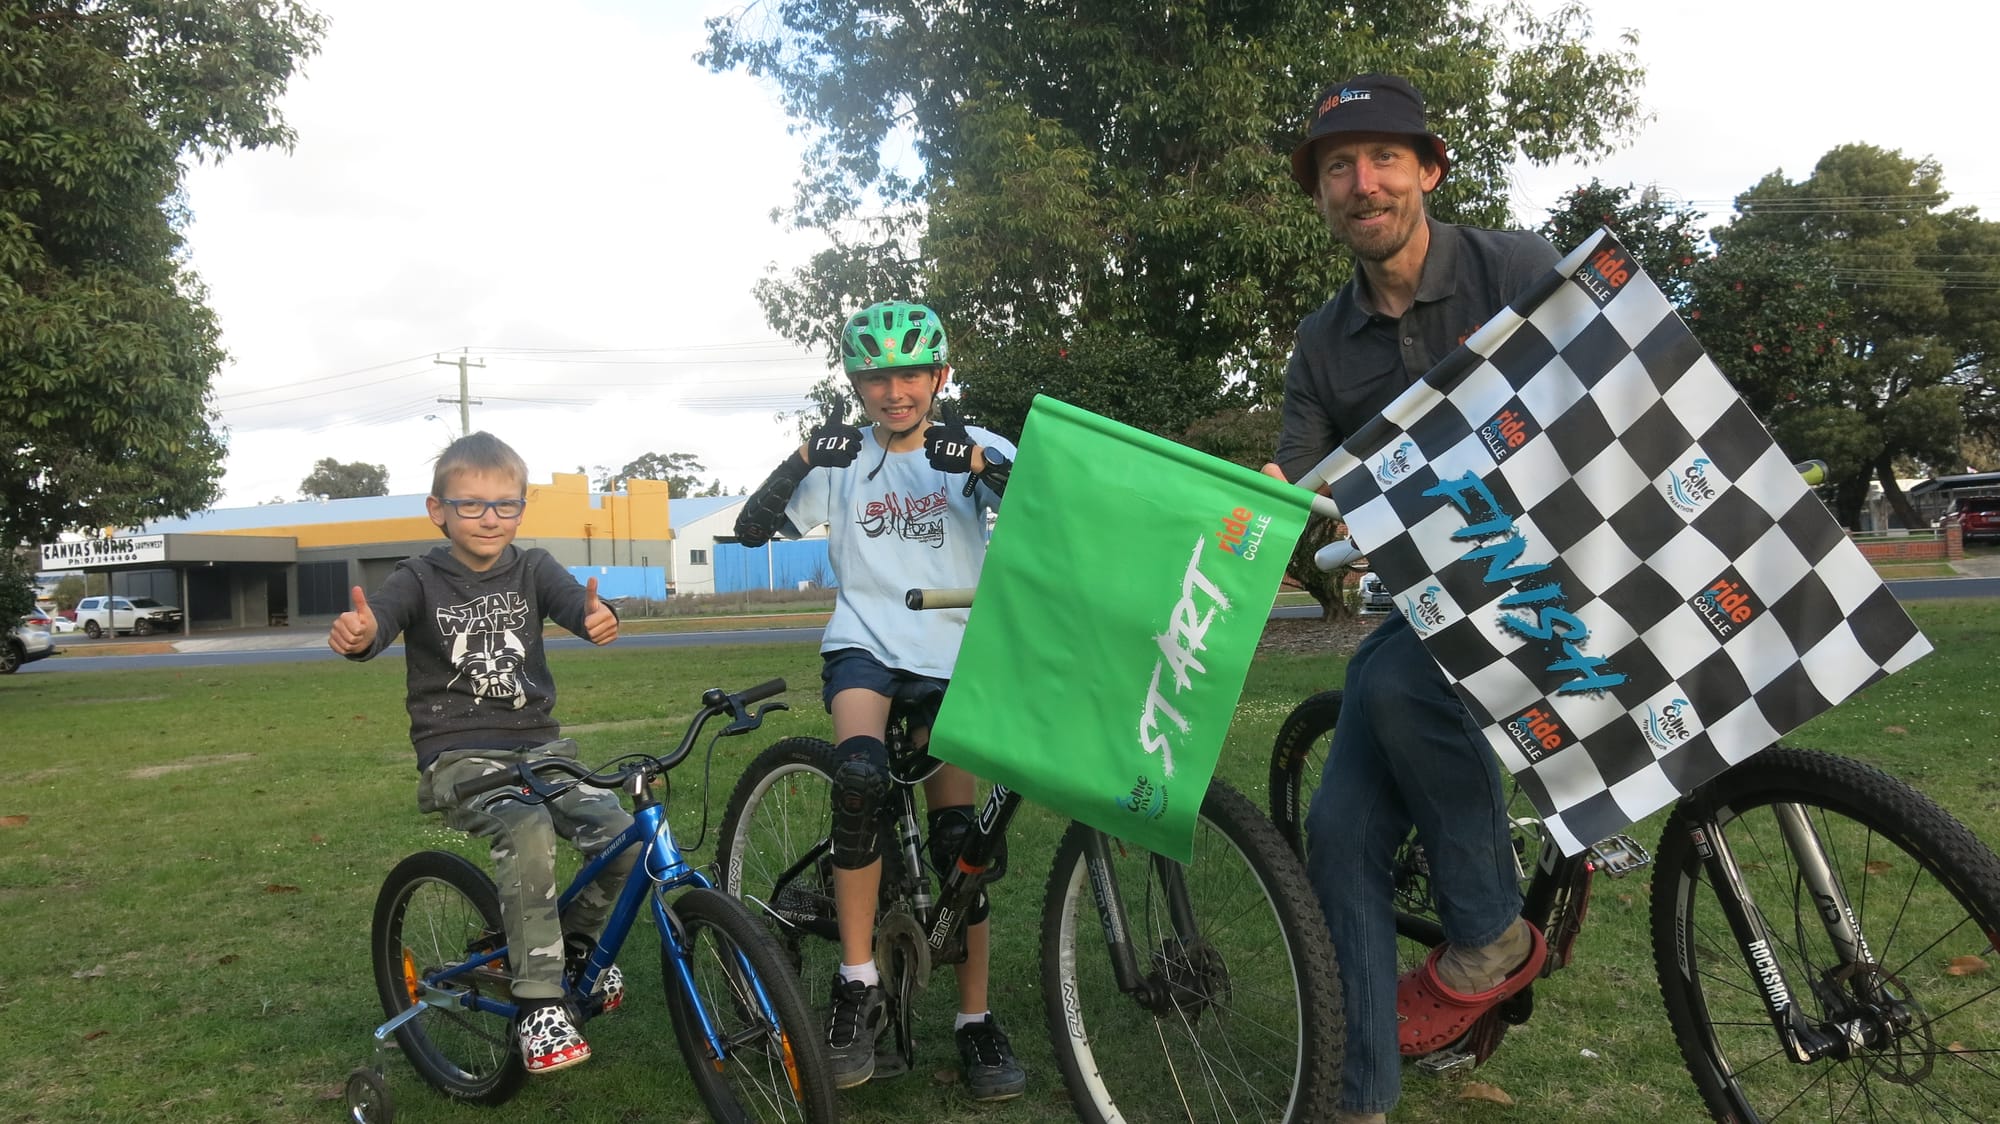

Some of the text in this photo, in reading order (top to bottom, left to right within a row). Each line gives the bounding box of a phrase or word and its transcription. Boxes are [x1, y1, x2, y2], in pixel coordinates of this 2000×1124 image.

[1318, 94, 1340, 119] ride
[1593, 249, 1629, 287] ride
[816, 436, 851, 451] FOX
[1497, 409, 1527, 448] ride
[935, 440, 968, 458] FOX
[1681, 479, 1704, 501] river
[1685, 466, 1716, 500] Collie
[1216, 506, 1253, 555] ride
[43, 543, 90, 560] CANVAS
[1421, 469, 1631, 692] FINISH
[437, 591, 528, 621] STAR
[437, 600, 529, 636] WARS
[1416, 604, 1435, 625] river
[1420, 593, 1446, 624] Collie
[1710, 579, 1752, 623] ride
[1137, 533, 1231, 778] START
[1520, 707, 1563, 750] ride
[1657, 716, 1678, 740] river
[1663, 705, 1690, 740] Collie
[1127, 775, 1148, 812] Collie
[929, 907, 954, 950] BMC
[1677, 916, 1686, 968] SRAM
[1749, 938, 1791, 1012] ROCKSHOX
